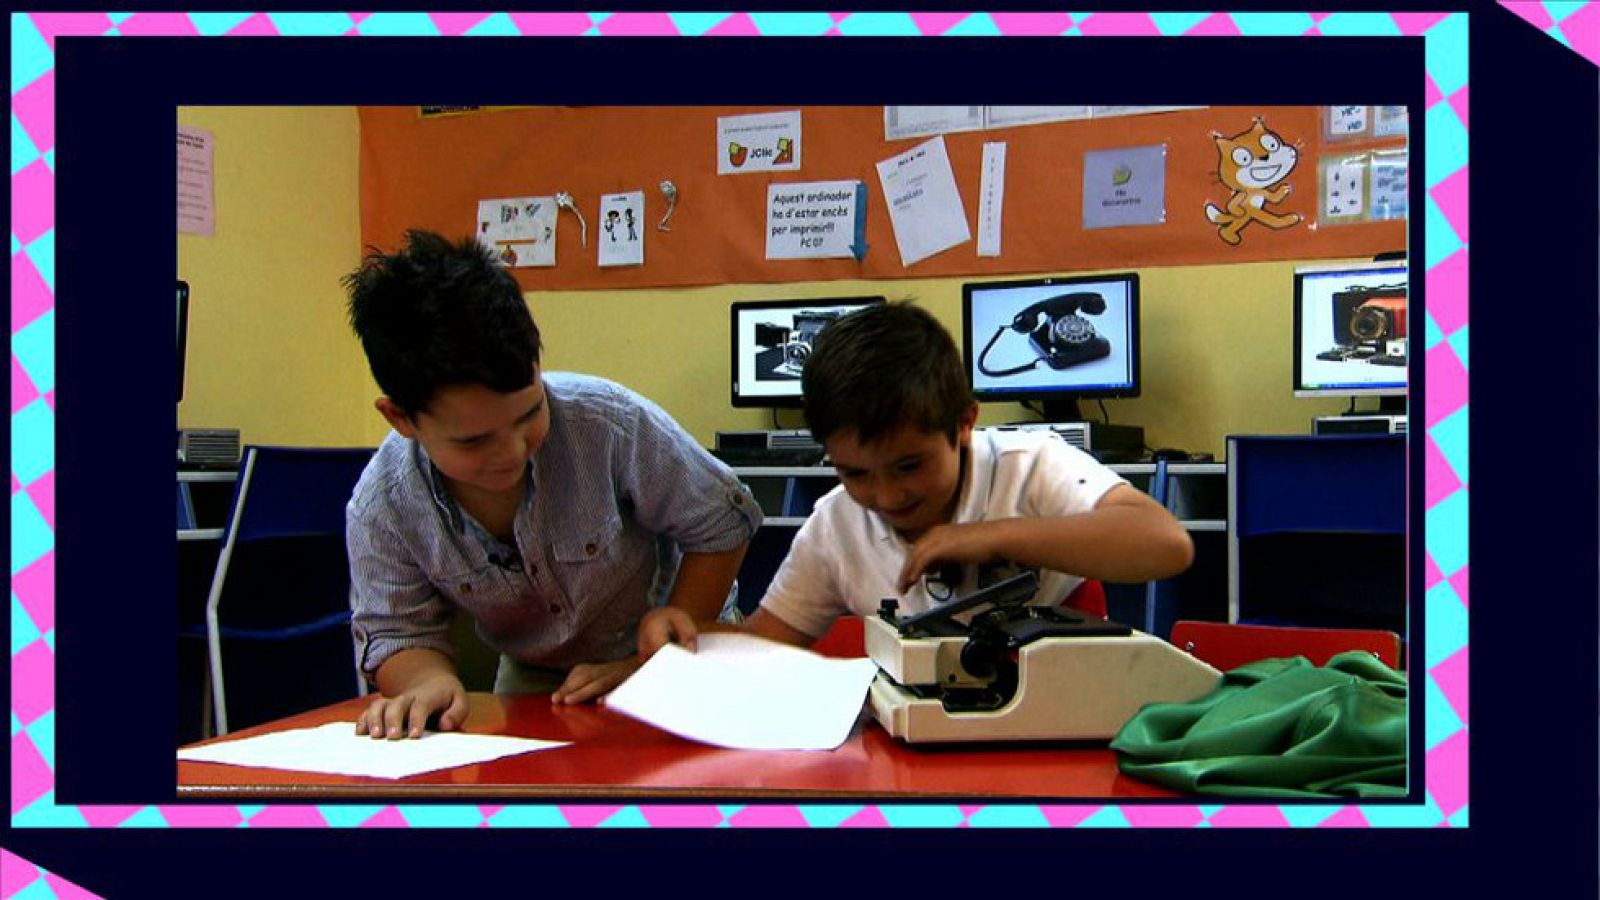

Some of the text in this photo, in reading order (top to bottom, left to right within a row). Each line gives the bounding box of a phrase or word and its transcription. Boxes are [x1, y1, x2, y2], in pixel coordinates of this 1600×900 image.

[773, 190, 852, 206] Aquest ordinador
[772, 210, 783, 219] ha
[772, 226, 788, 238] per
